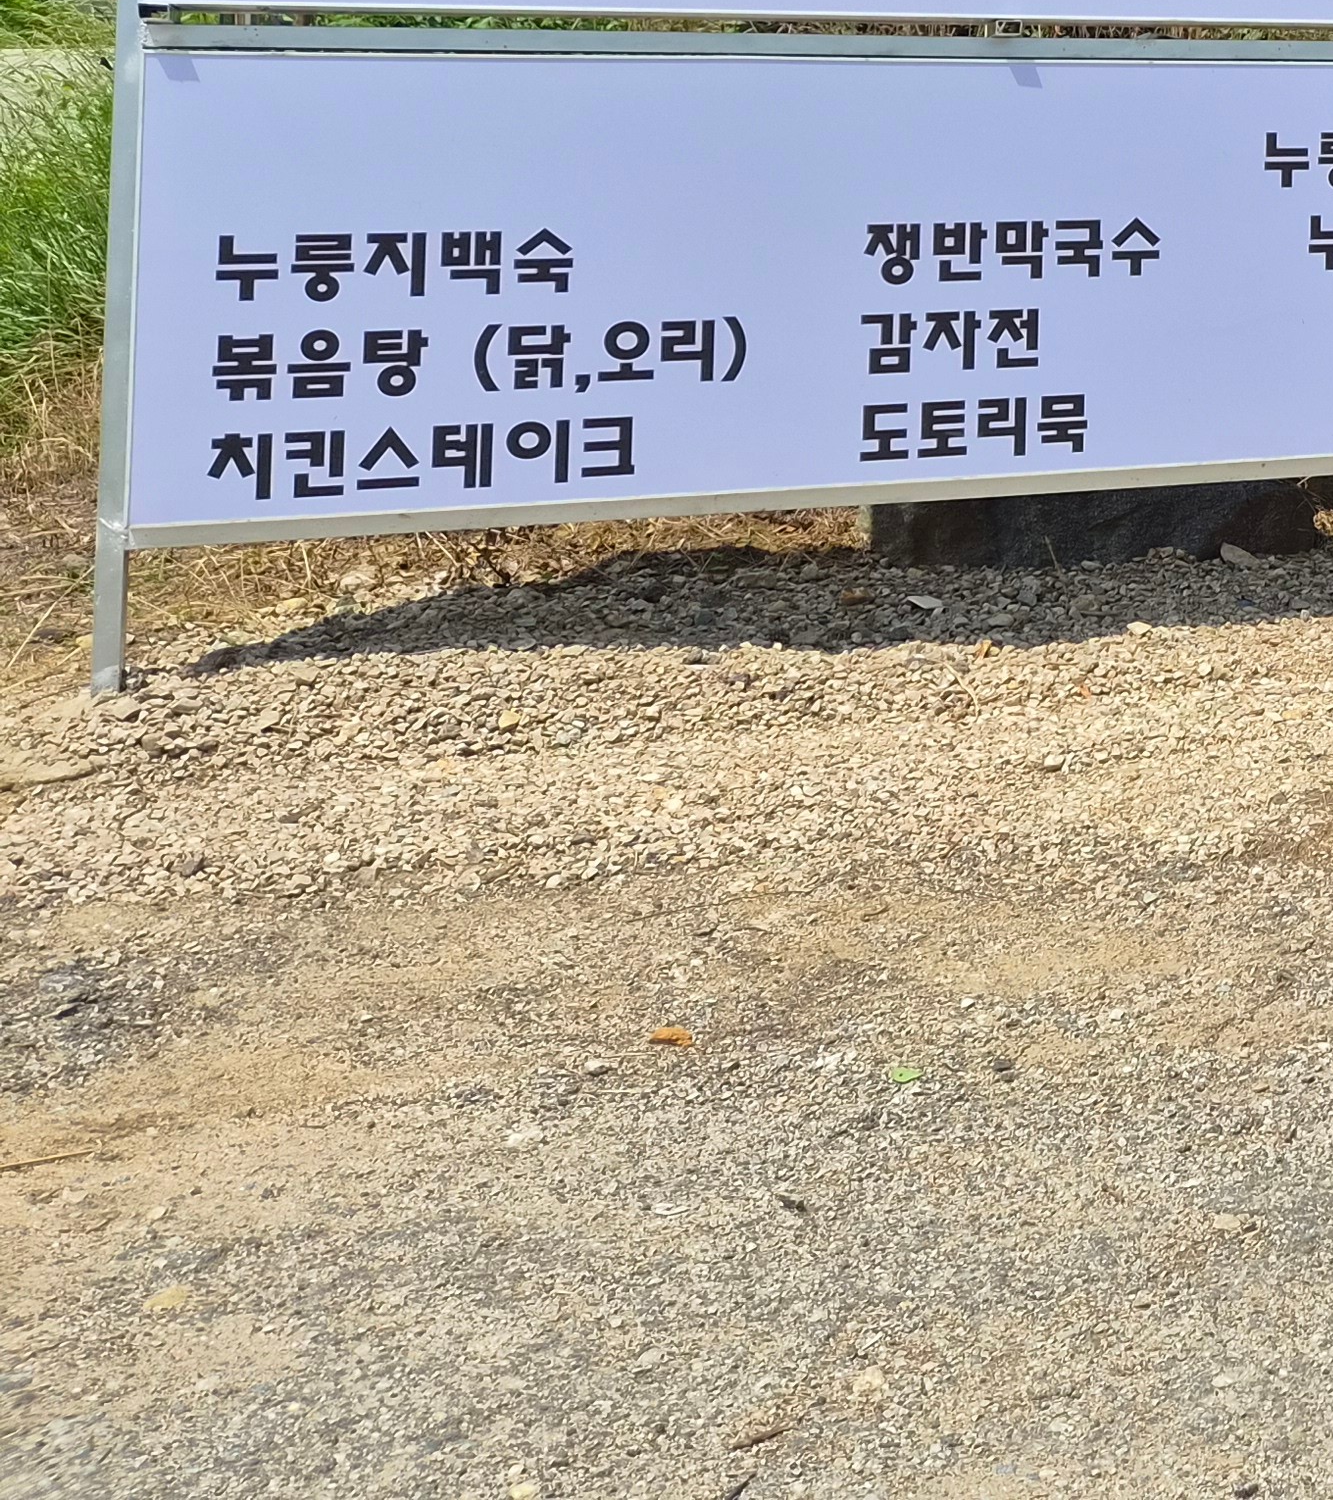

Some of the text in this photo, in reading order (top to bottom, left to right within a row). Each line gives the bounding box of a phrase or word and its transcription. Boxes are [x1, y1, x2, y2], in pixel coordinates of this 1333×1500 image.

[215, 228, 574, 302] 누룽지백숙
[863, 217, 1161, 285] 쟁반막국수
[211, 316, 747, 402] 볶음탕 (닭,오리)
[860, 308, 1039, 375] 감자전
[207, 416, 635, 501] 치킨스테이크
[859, 393, 1088, 462] 도토리묵
